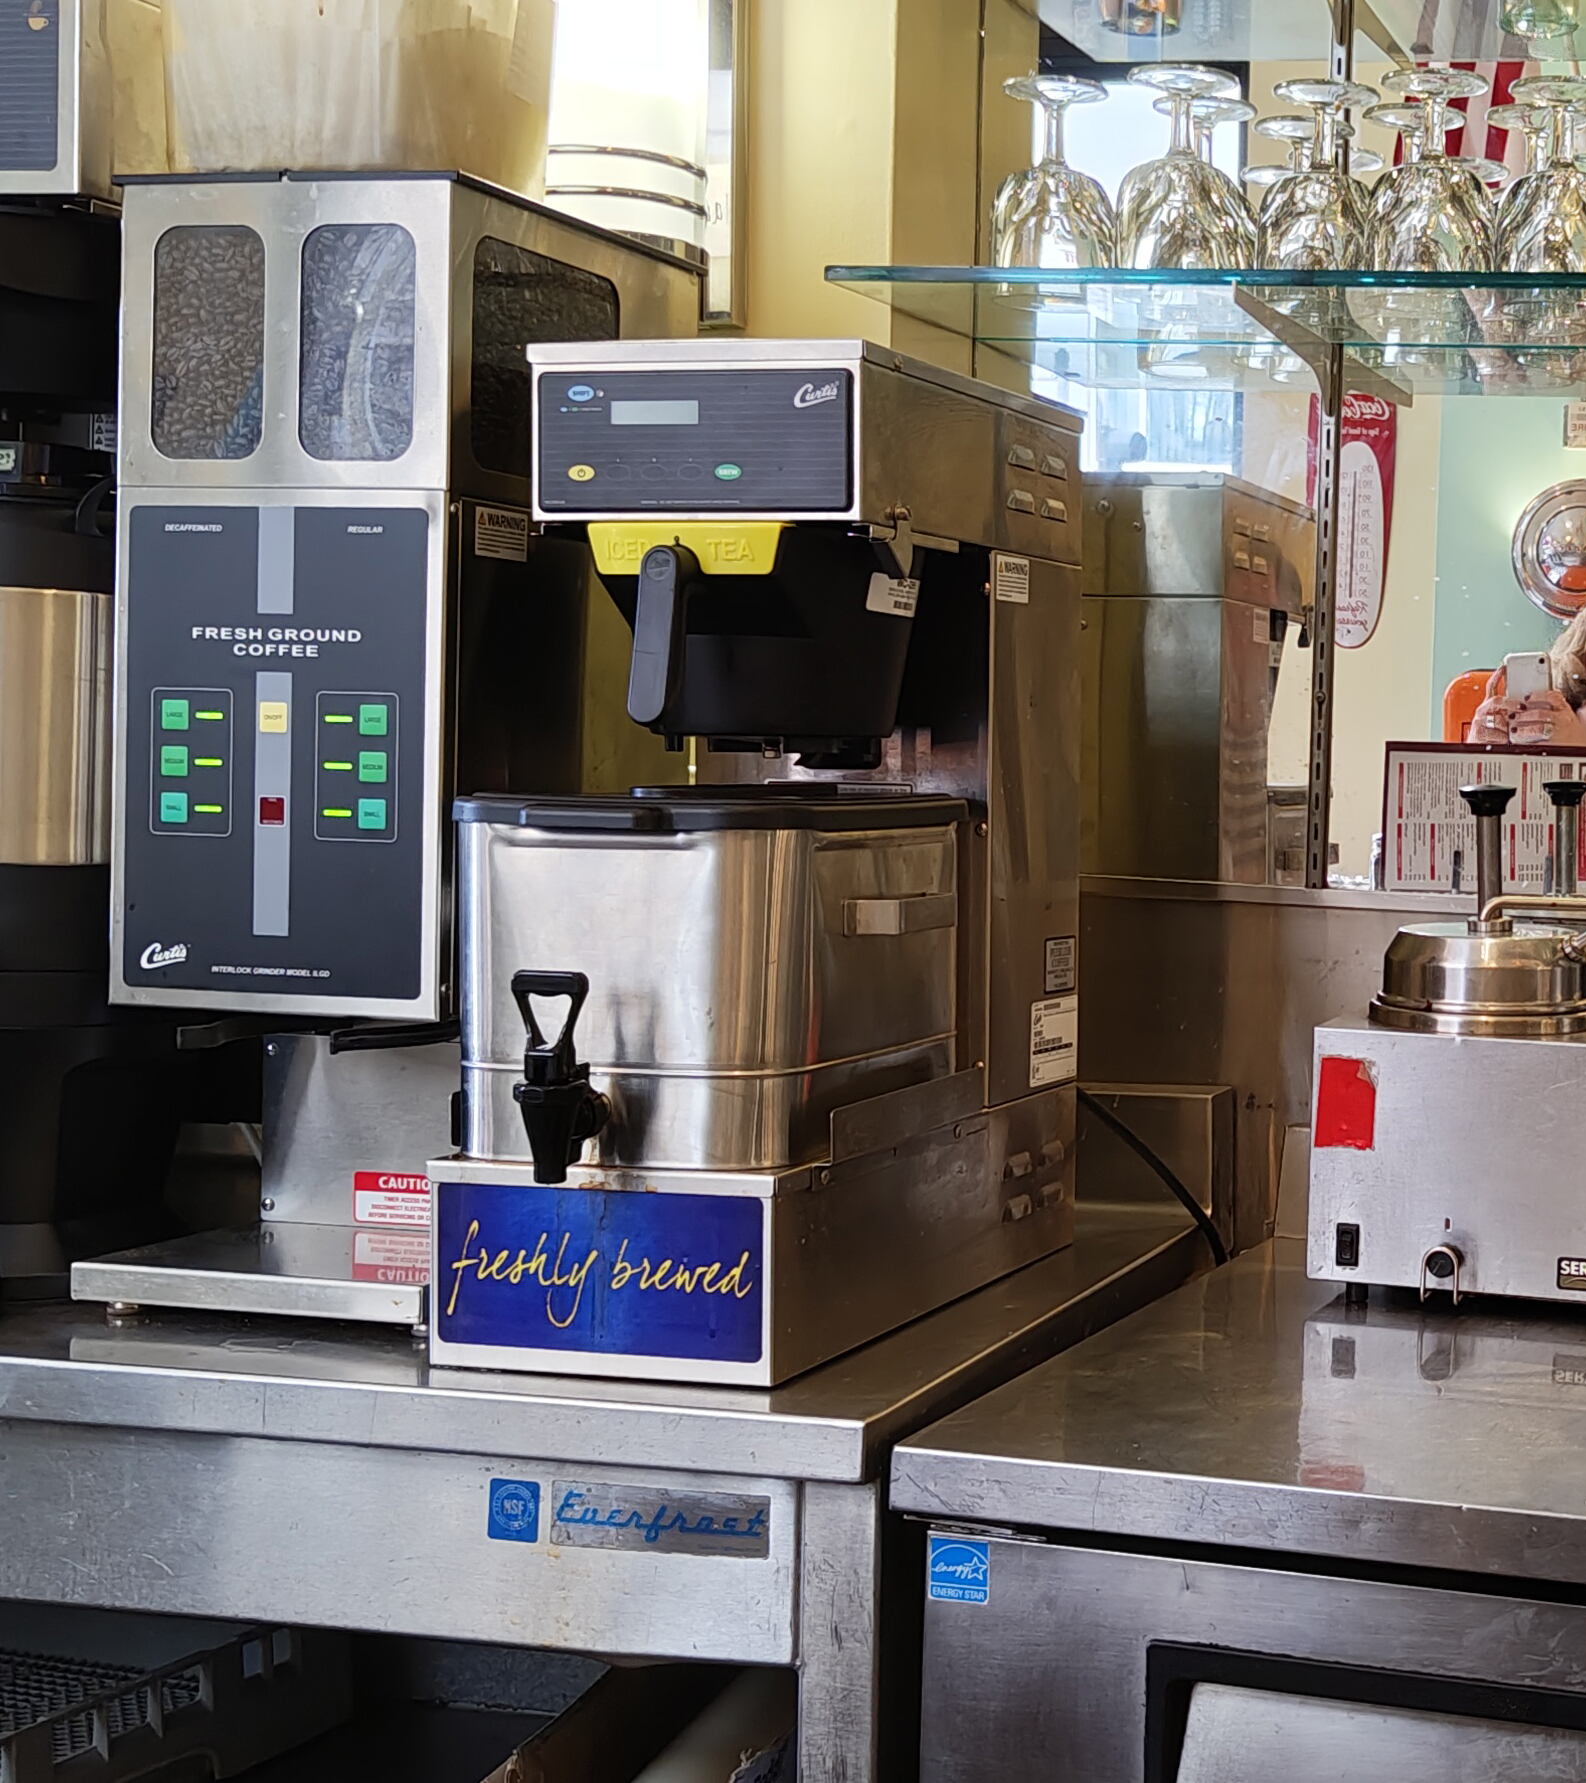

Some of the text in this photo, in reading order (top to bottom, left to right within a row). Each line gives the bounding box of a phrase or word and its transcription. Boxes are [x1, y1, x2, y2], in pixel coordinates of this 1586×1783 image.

[794, 382, 838, 408] Curtis
[165, 524, 222, 532] DECAFFEINATED
[347, 526, 383, 534] REGULAR
[706, 539, 754, 561] TEA
[1004, 562, 1028, 576] WARNING
[191, 627, 362, 642] FRESH GROUND
[233, 644, 319, 657] COFFEE
[140, 942, 187, 969] Curtis
[211, 965, 252, 974] INTERLOCK
[253, 967, 286, 976] GRINDER
[286, 969, 311, 977] MODEL
[378, 1177, 430, 1191] CAUTIO
[447, 1220, 753, 1328] freshly brewed
[503, 1499, 525, 1515] NSF
[932, 1587, 985, 1600] ENERGY STAR
